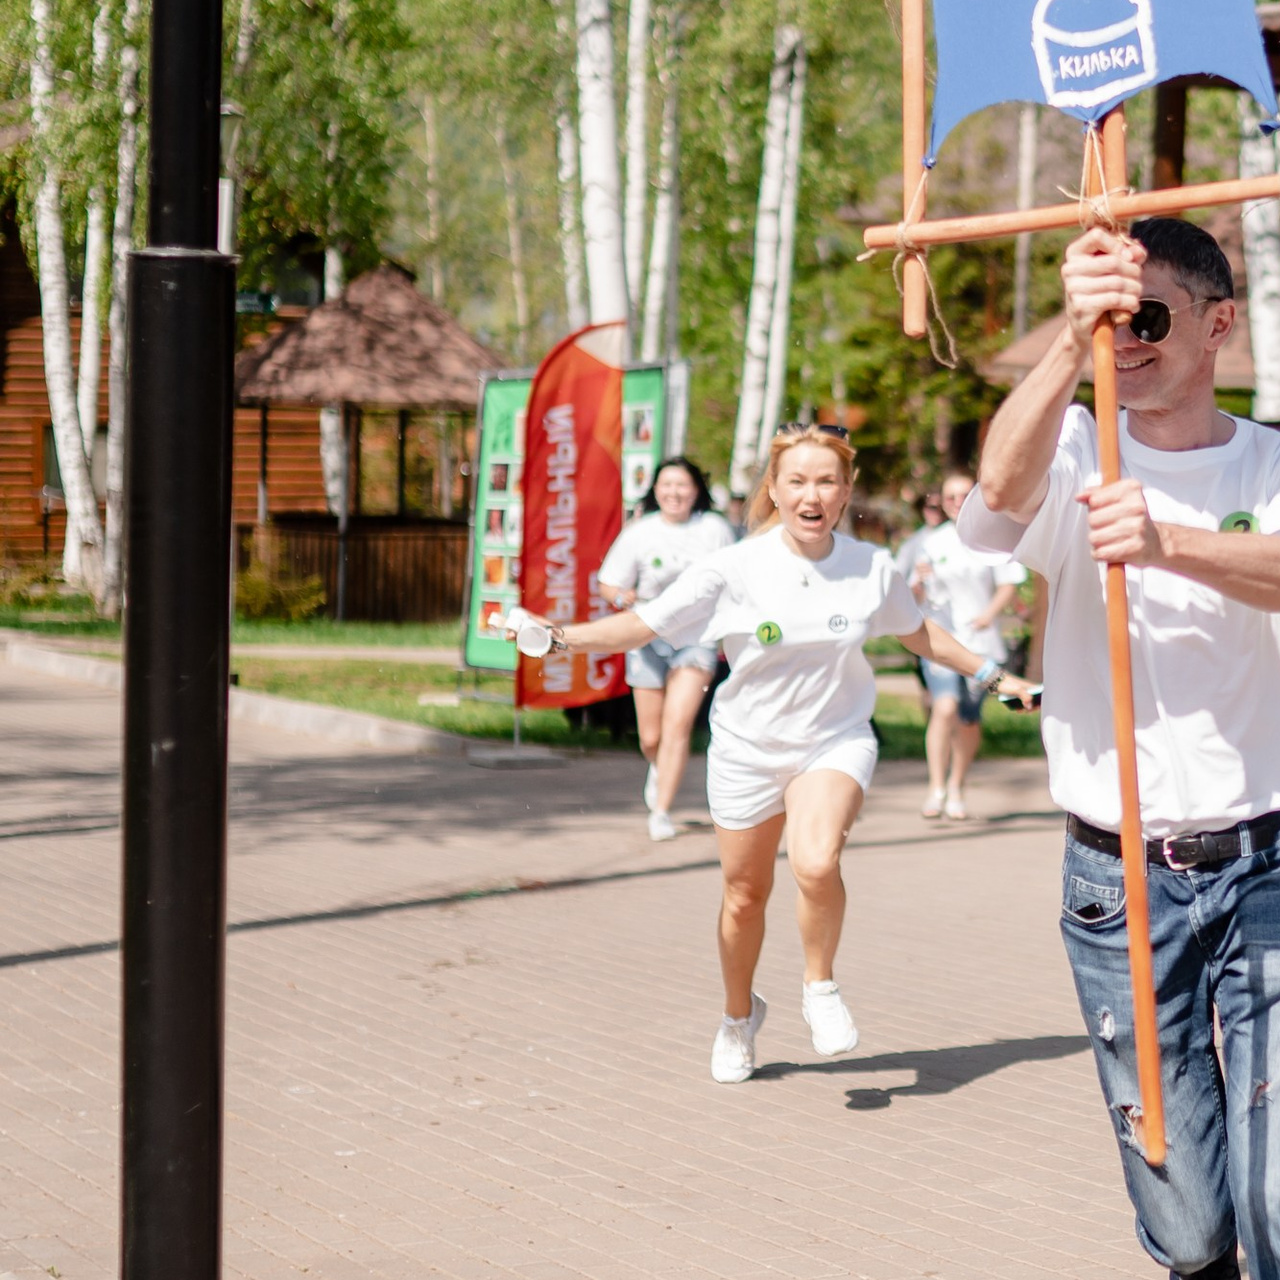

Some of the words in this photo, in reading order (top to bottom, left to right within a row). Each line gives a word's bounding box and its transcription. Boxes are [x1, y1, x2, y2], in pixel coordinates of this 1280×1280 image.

[1059, 45, 1140, 80] КИЛЬКА
[543, 403, 578, 693] МУЫКАЛЬНЫЙ
[761, 624, 777, 643] 2
